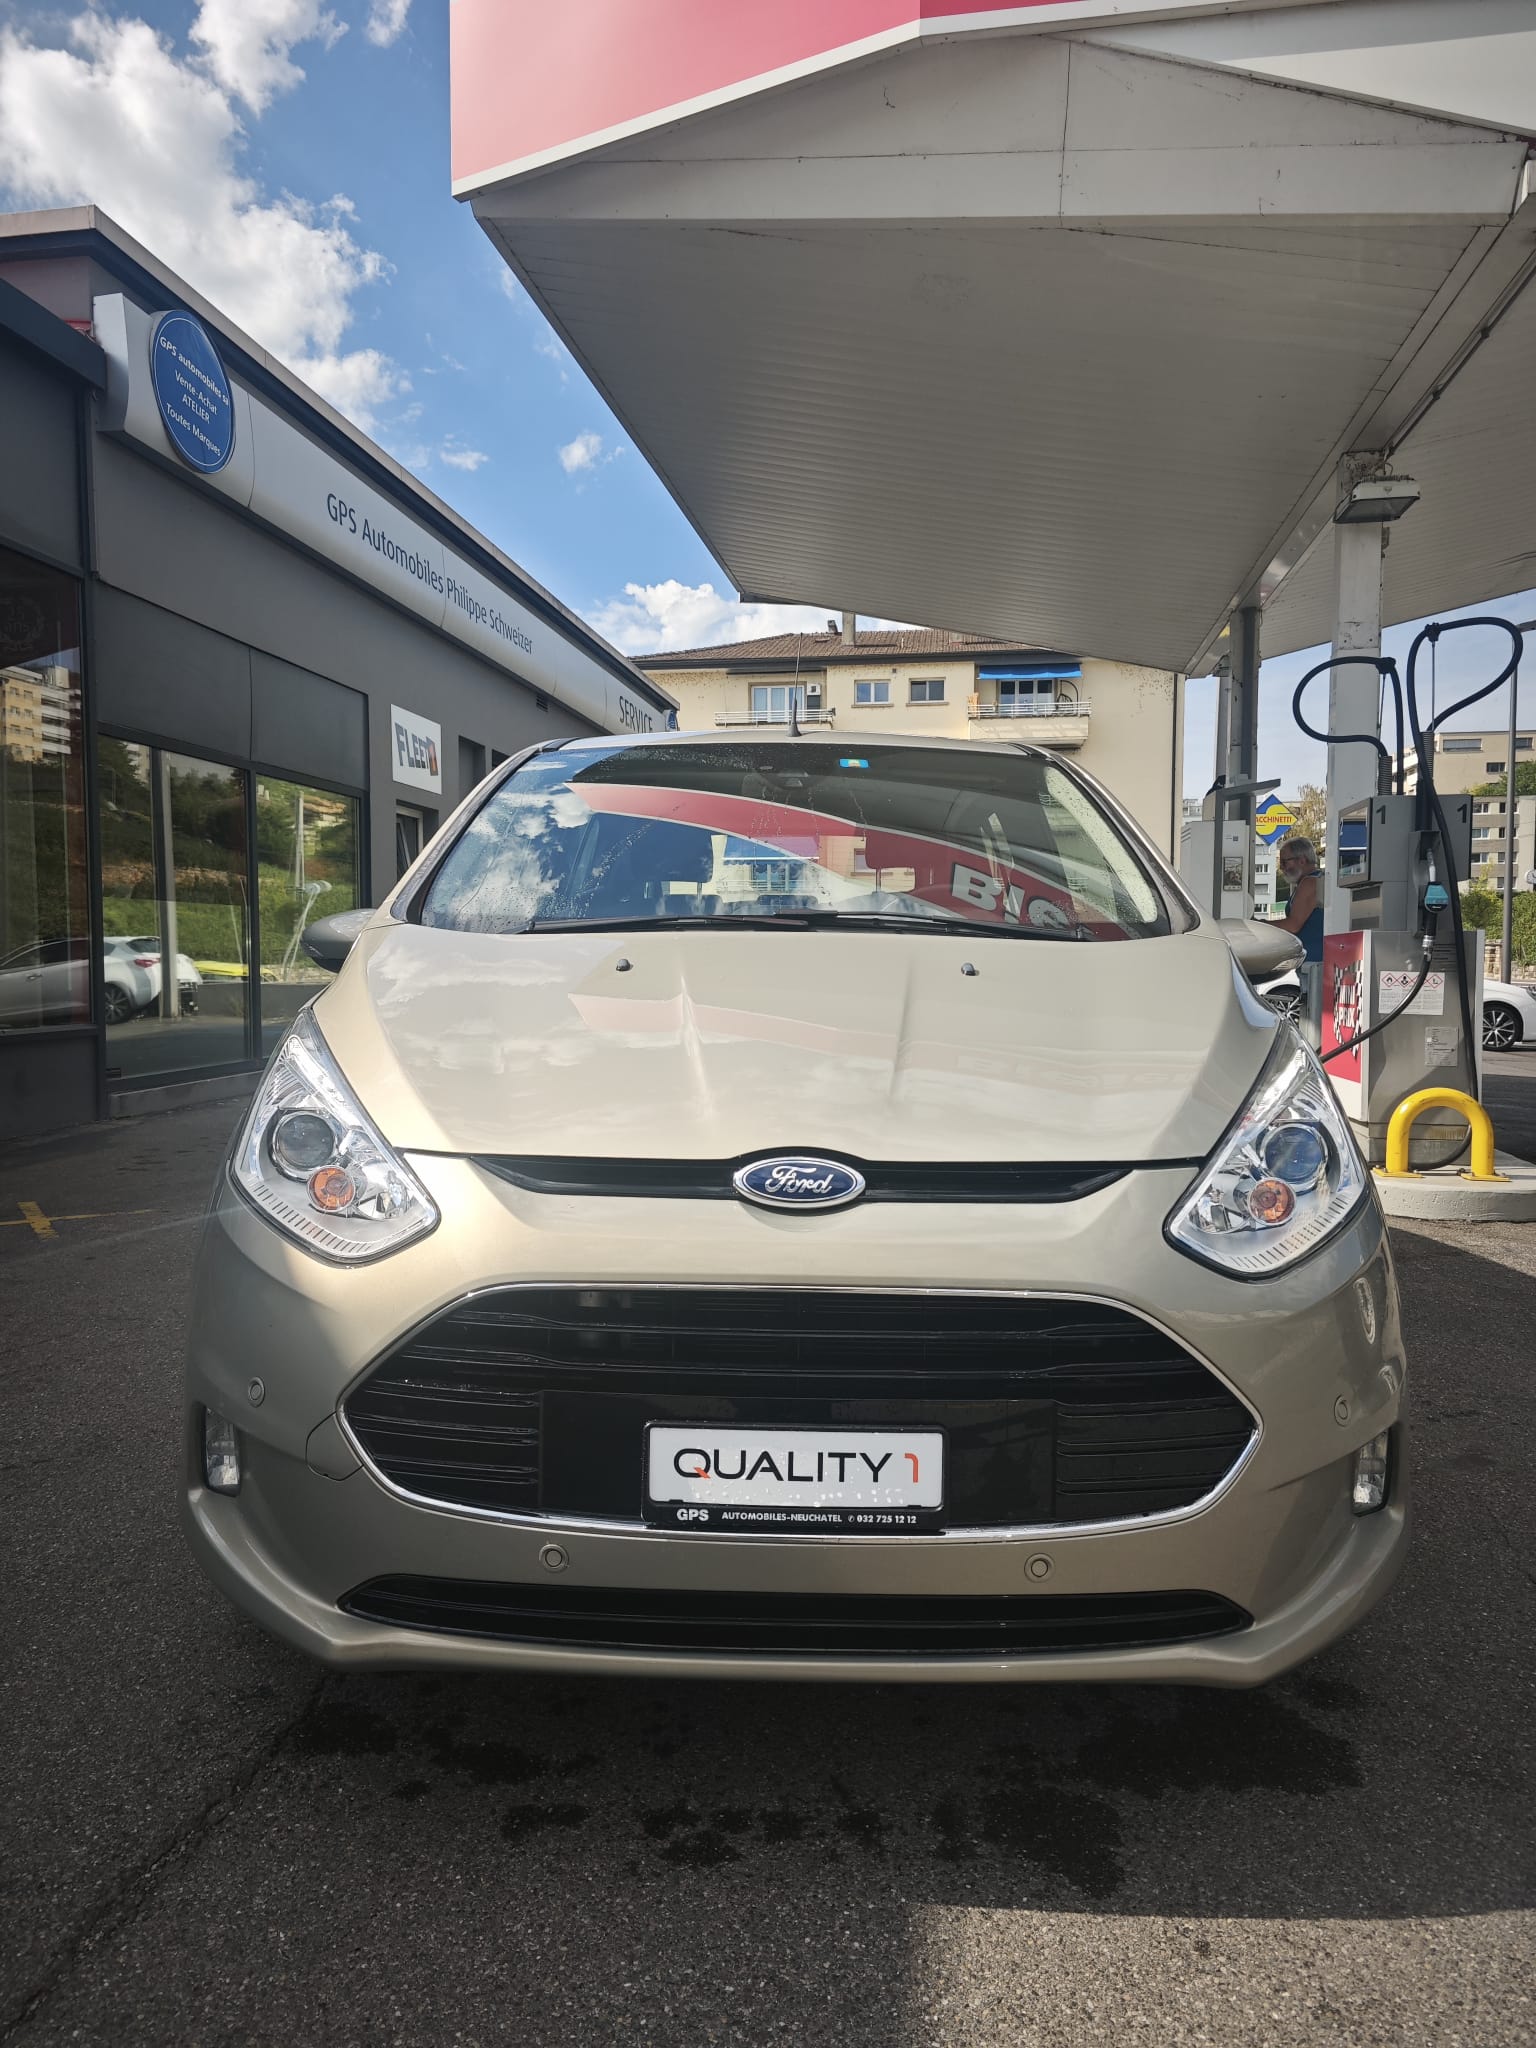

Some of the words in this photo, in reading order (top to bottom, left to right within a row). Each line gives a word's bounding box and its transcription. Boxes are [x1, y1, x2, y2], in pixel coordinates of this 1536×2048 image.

[160, 336, 177, 357] GPS
[178, 352, 222, 398] automobiles
[174, 370, 217, 415] Vente-Achat
[182, 394, 210, 424] ATELIER
[166, 403, 191, 431] Toutes
[192, 424, 221, 457] Marques
[327, 493, 357, 534] GPS
[362, 518, 444, 594] Automobiles
[446, 577, 487, 624] Philippe
[489, 609, 533, 654] Schweizer
[1376, 805, 1386, 825] 1
[1457, 804, 1467, 823] 1
[1339, 1007, 1355, 1028] PRIX
[765, 1165, 834, 1193] Ford
[673, 1448, 893, 1483] QUALITY
[904, 1452, 919, 1483] 1
[676, 1508, 709, 1522] GPS
[721, 1511, 843, 1523] AUTOMOBILES-NEUCHATEL
[856, 1514, 874, 1524] 032
[876, 1514, 893, 1524] 725
[895, 1515, 905, 1524] 12
[907, 1515, 917, 1524] 12
